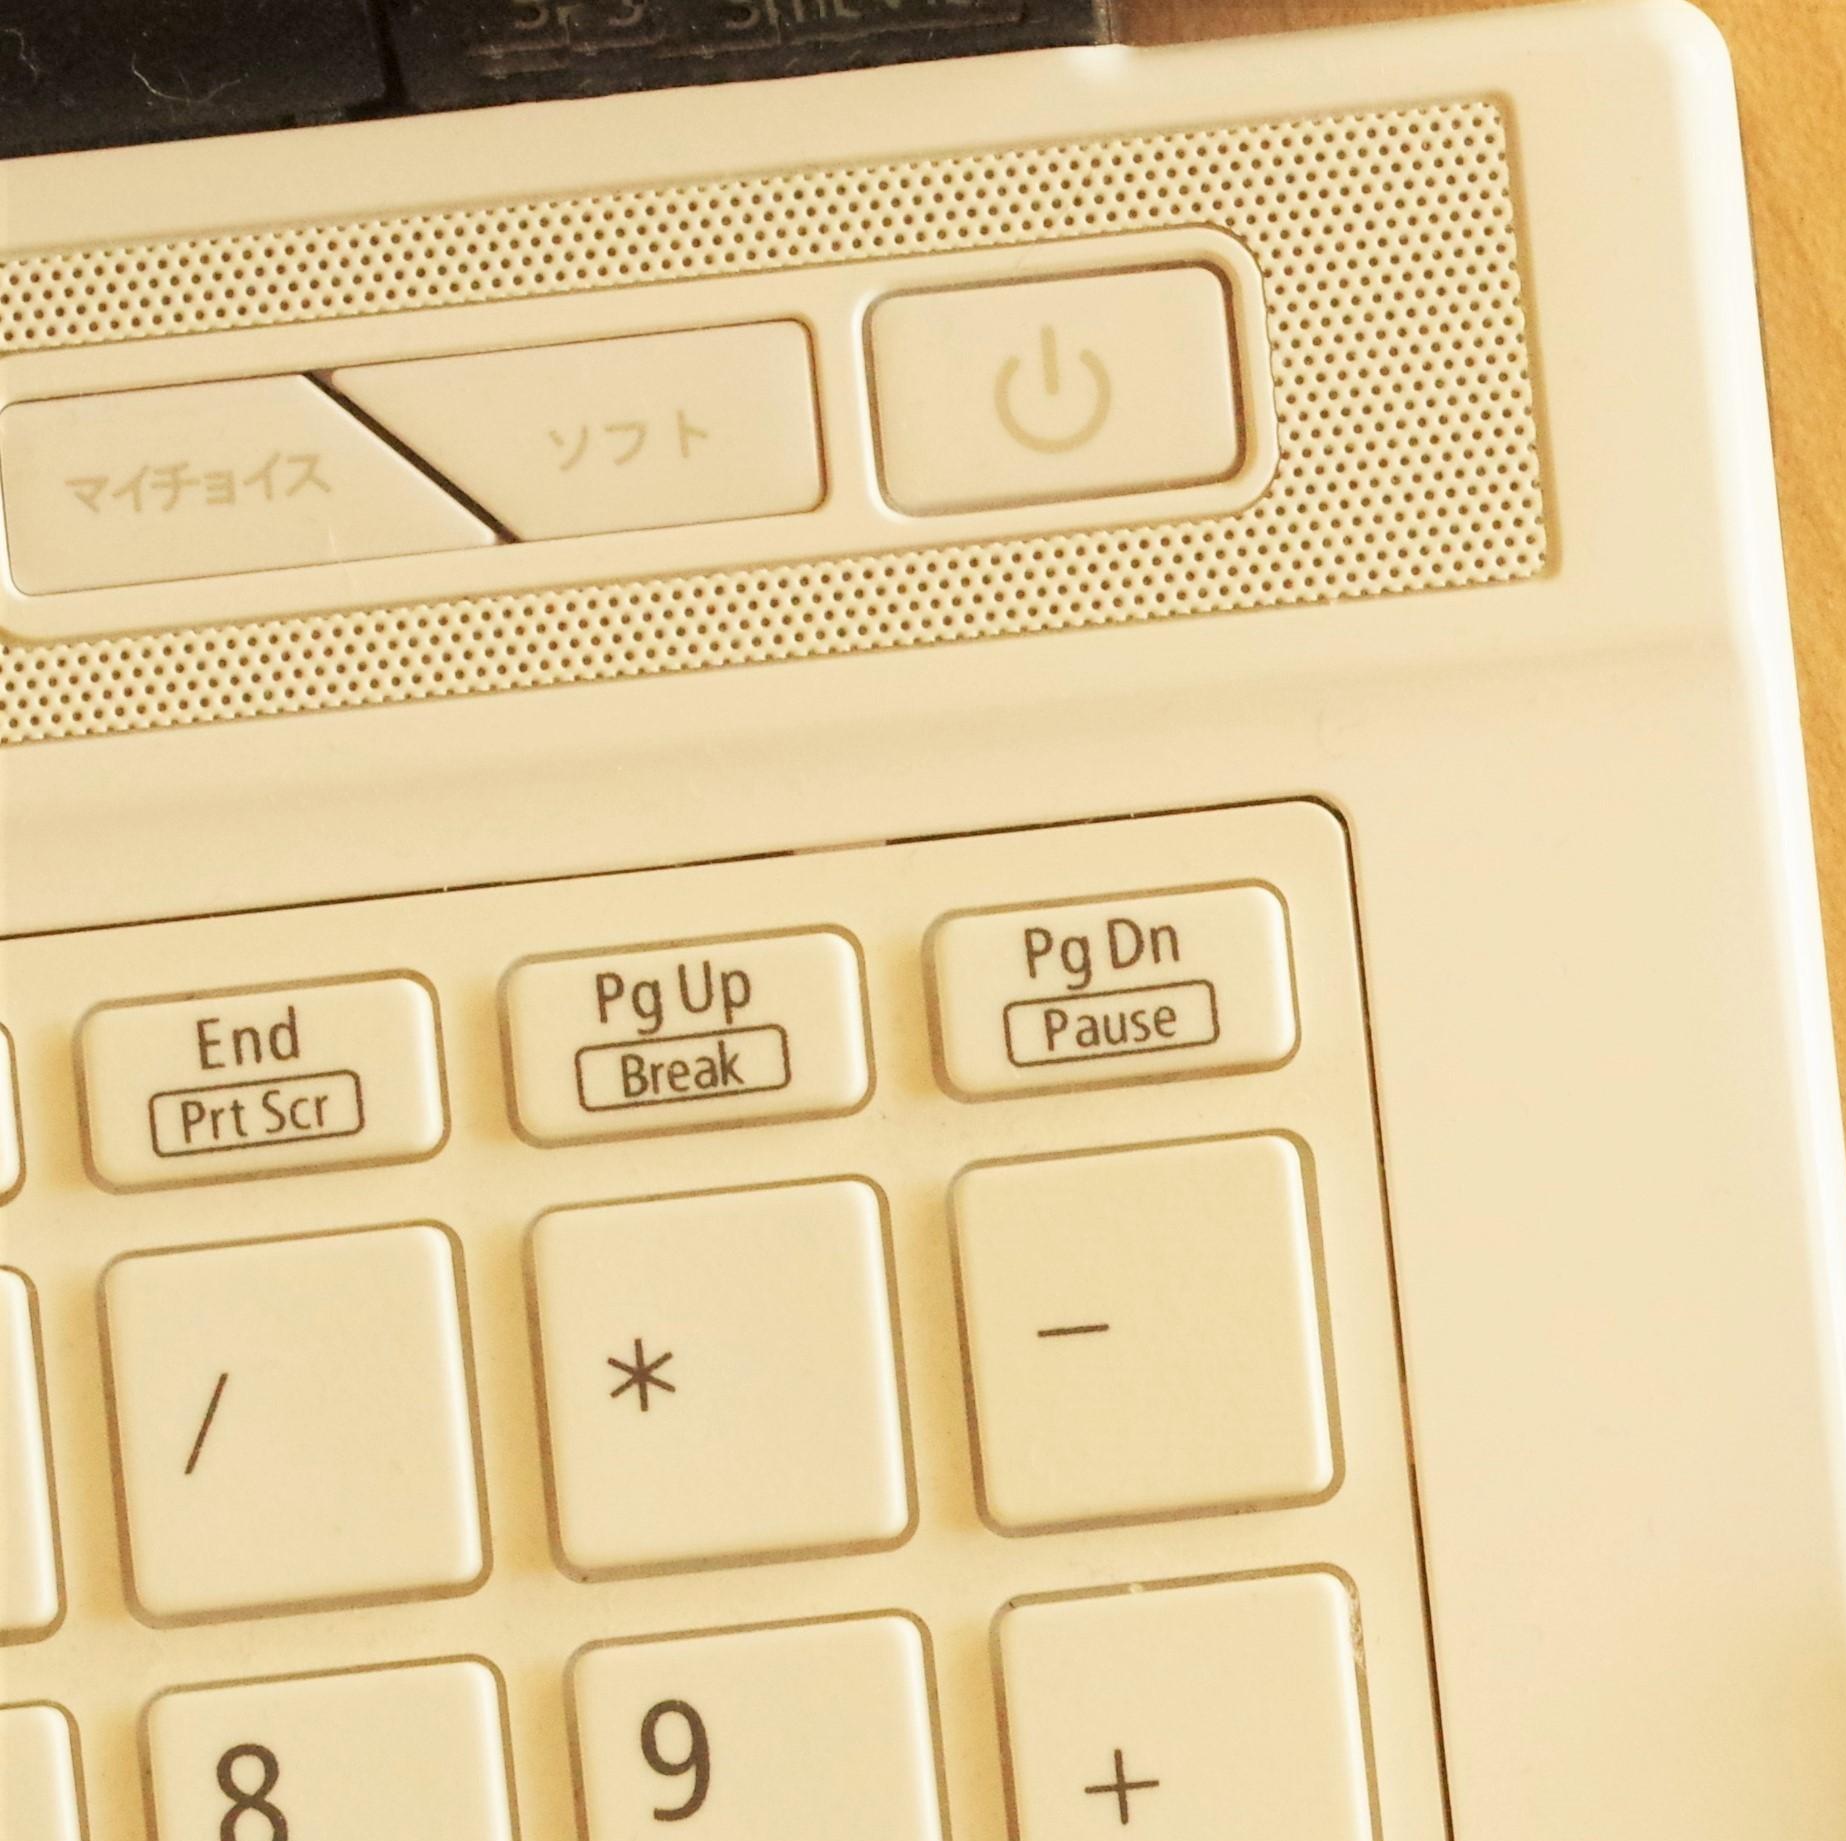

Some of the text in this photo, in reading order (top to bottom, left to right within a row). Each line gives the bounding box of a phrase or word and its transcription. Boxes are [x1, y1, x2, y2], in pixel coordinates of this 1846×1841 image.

[548, 409, 709, 471] ソフト
[65, 451, 332, 513] マイチョイス
[1024, 917, 1180, 991] Pg Dn
[595, 959, 752, 1036] Pg Up
[1043, 1005, 1178, 1052] Pause
[196, 1005, 300, 1071] End
[620, 1039, 745, 1098] Break
[180, 1089, 329, 1144] Prt Scr
[640, 1698, 711, 1823] 9
